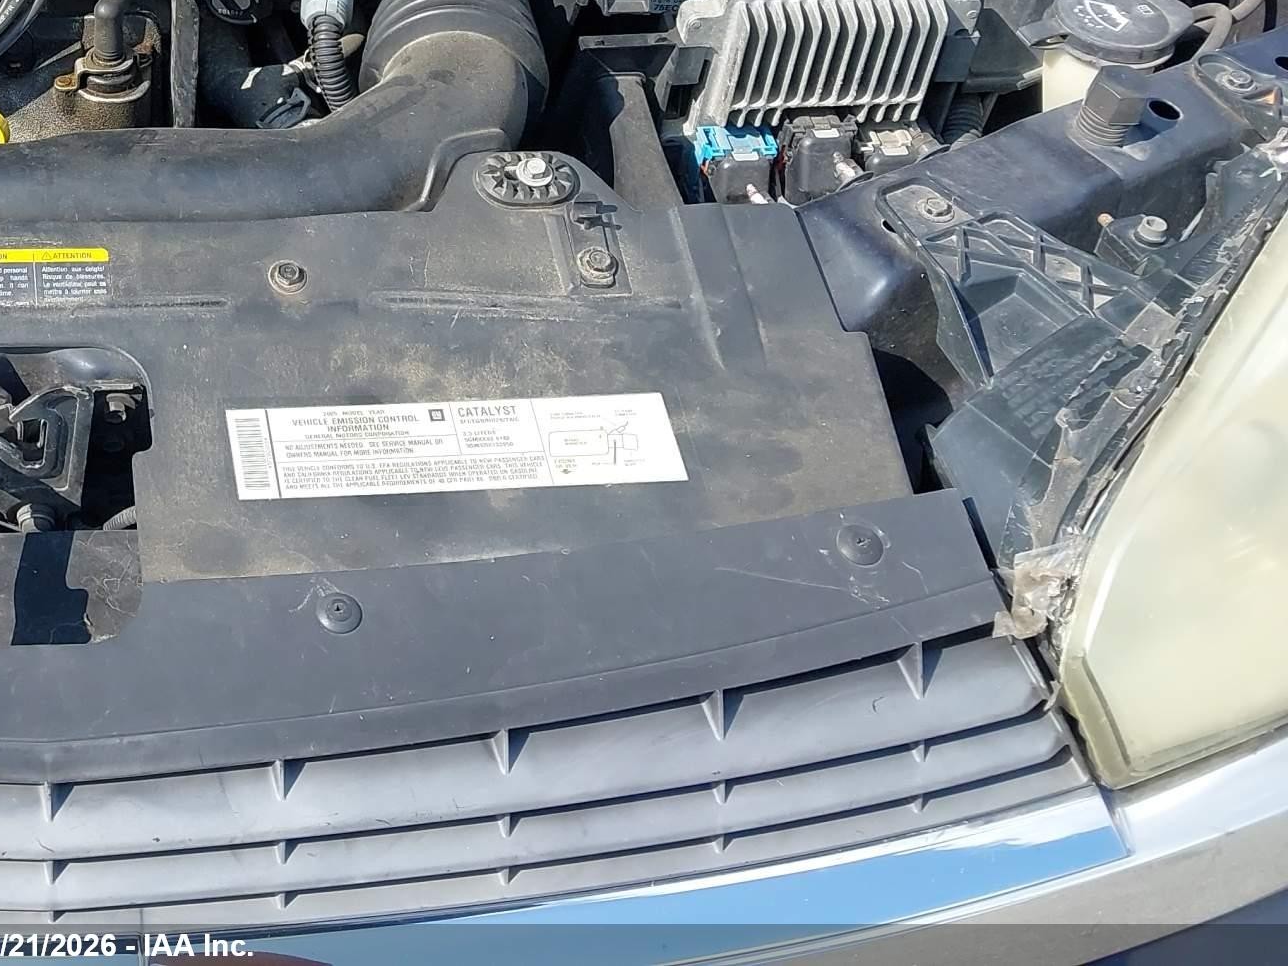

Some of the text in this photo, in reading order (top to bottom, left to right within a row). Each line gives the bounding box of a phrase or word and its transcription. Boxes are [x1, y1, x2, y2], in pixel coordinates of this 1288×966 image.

[458, 406, 516, 418] CATALYST
[378, 415, 419, 423] CONTROL
[328, 423, 389, 432] INFORMATION
